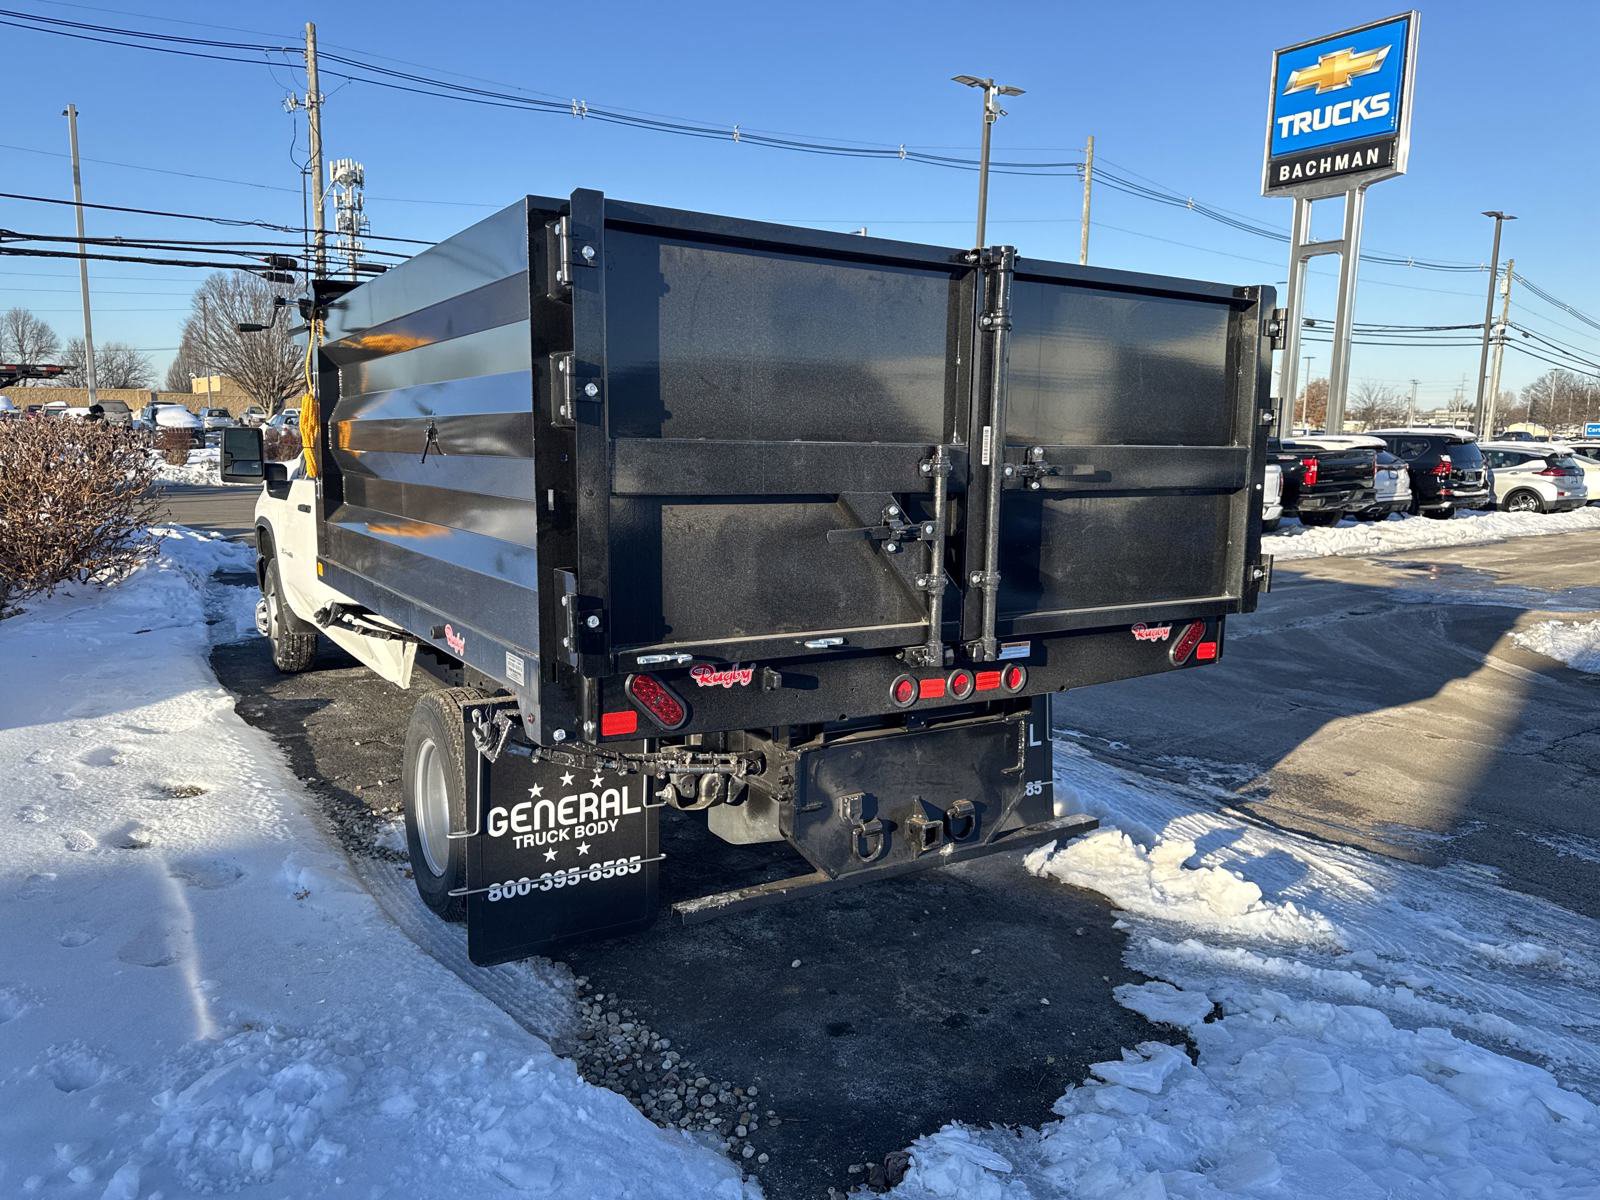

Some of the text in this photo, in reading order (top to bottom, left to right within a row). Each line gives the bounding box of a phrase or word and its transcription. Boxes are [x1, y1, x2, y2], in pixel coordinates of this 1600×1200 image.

[1278, 92, 1390, 138] TRUCKS
[1279, 148, 1379, 181] BACHMAN
[690, 663, 756, 688] Rugby
[487, 786, 641, 838] GENERAL
[513, 818, 619, 849] TRUCK BODY
[487, 855, 642, 902] 800-395-8585
